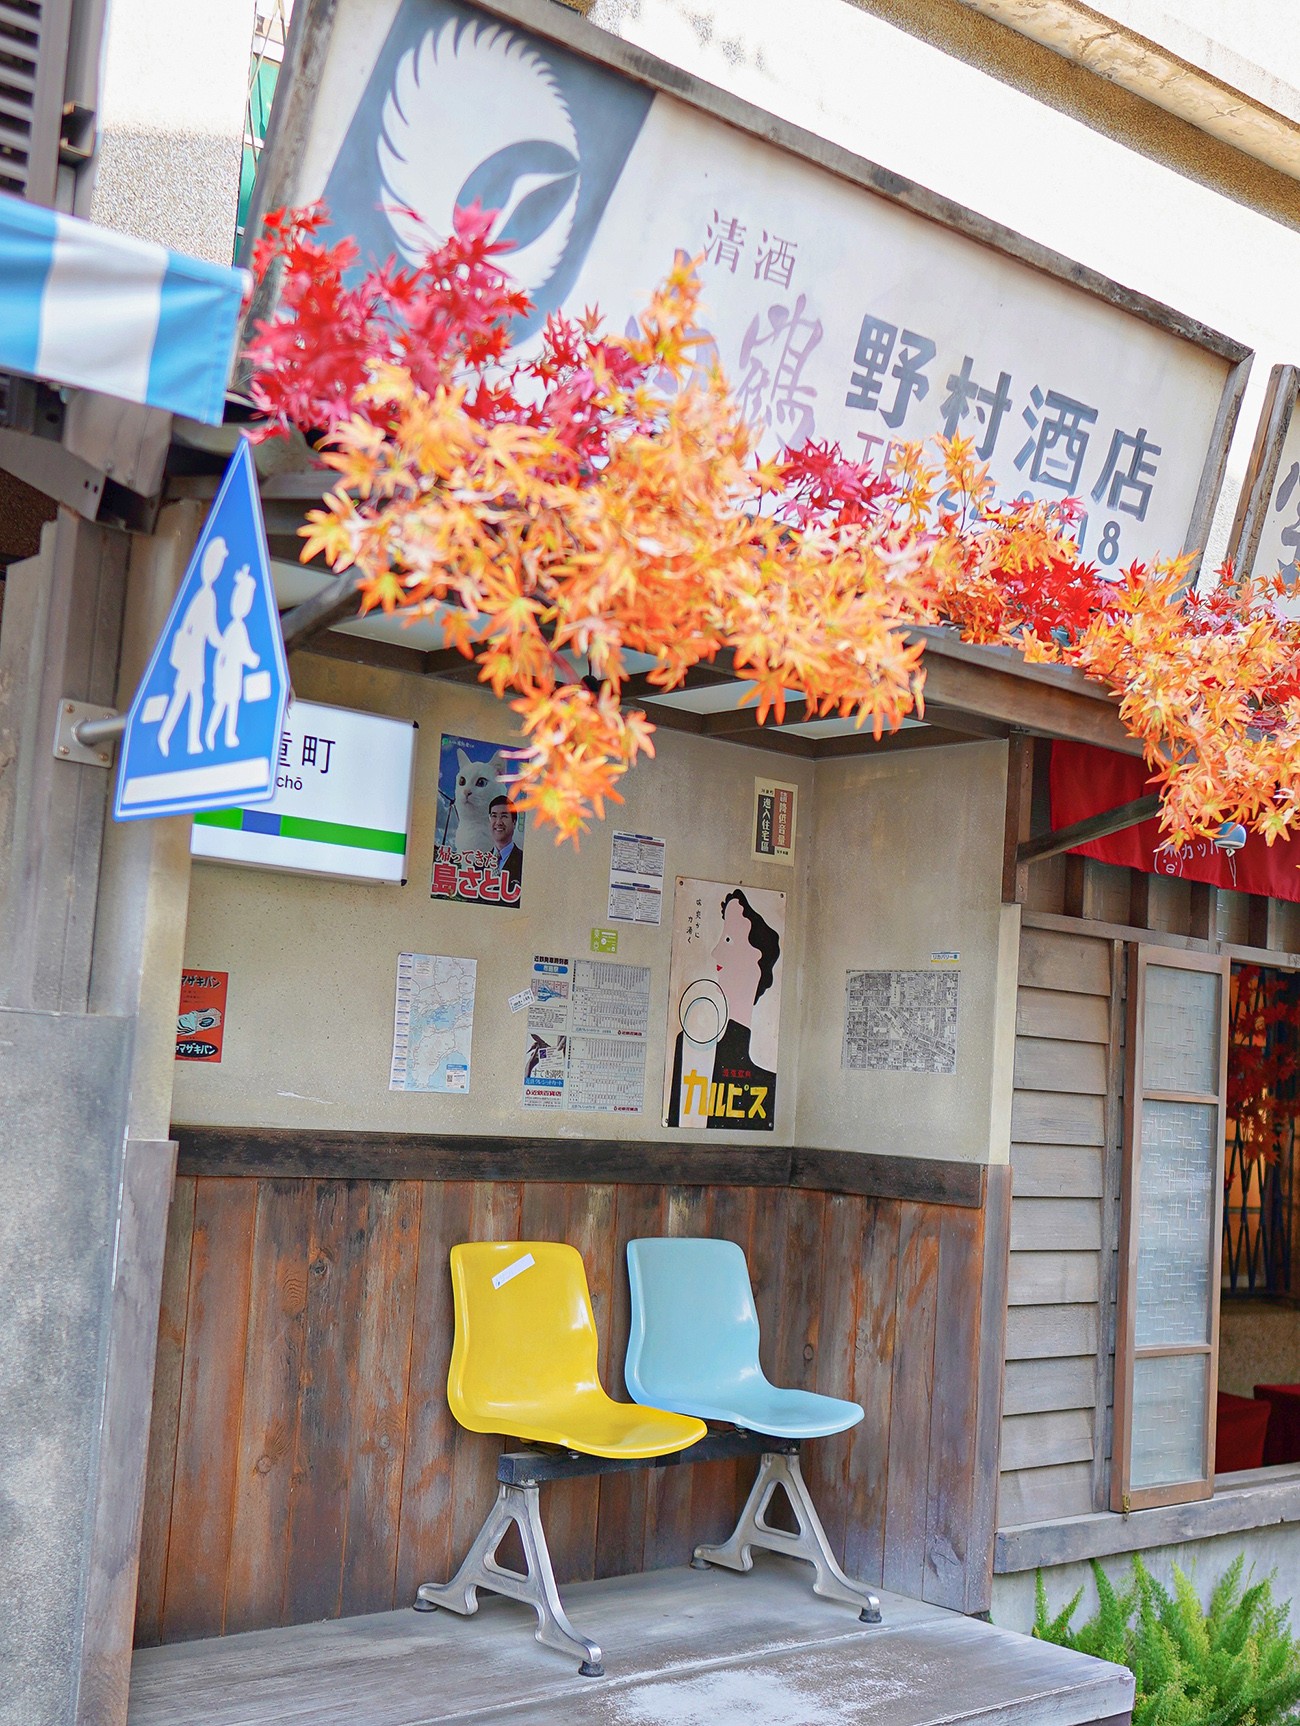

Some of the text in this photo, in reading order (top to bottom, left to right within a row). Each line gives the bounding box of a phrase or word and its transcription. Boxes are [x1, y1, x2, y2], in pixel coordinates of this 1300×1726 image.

[703, 208, 798, 290] 清酒
[845, 314, 1163, 523] 野村酒店
[437, 845, 498, 868] 帰ってきた
[431, 862, 521, 903] 島さとし
[683, 1069, 768, 1119] カルピス
